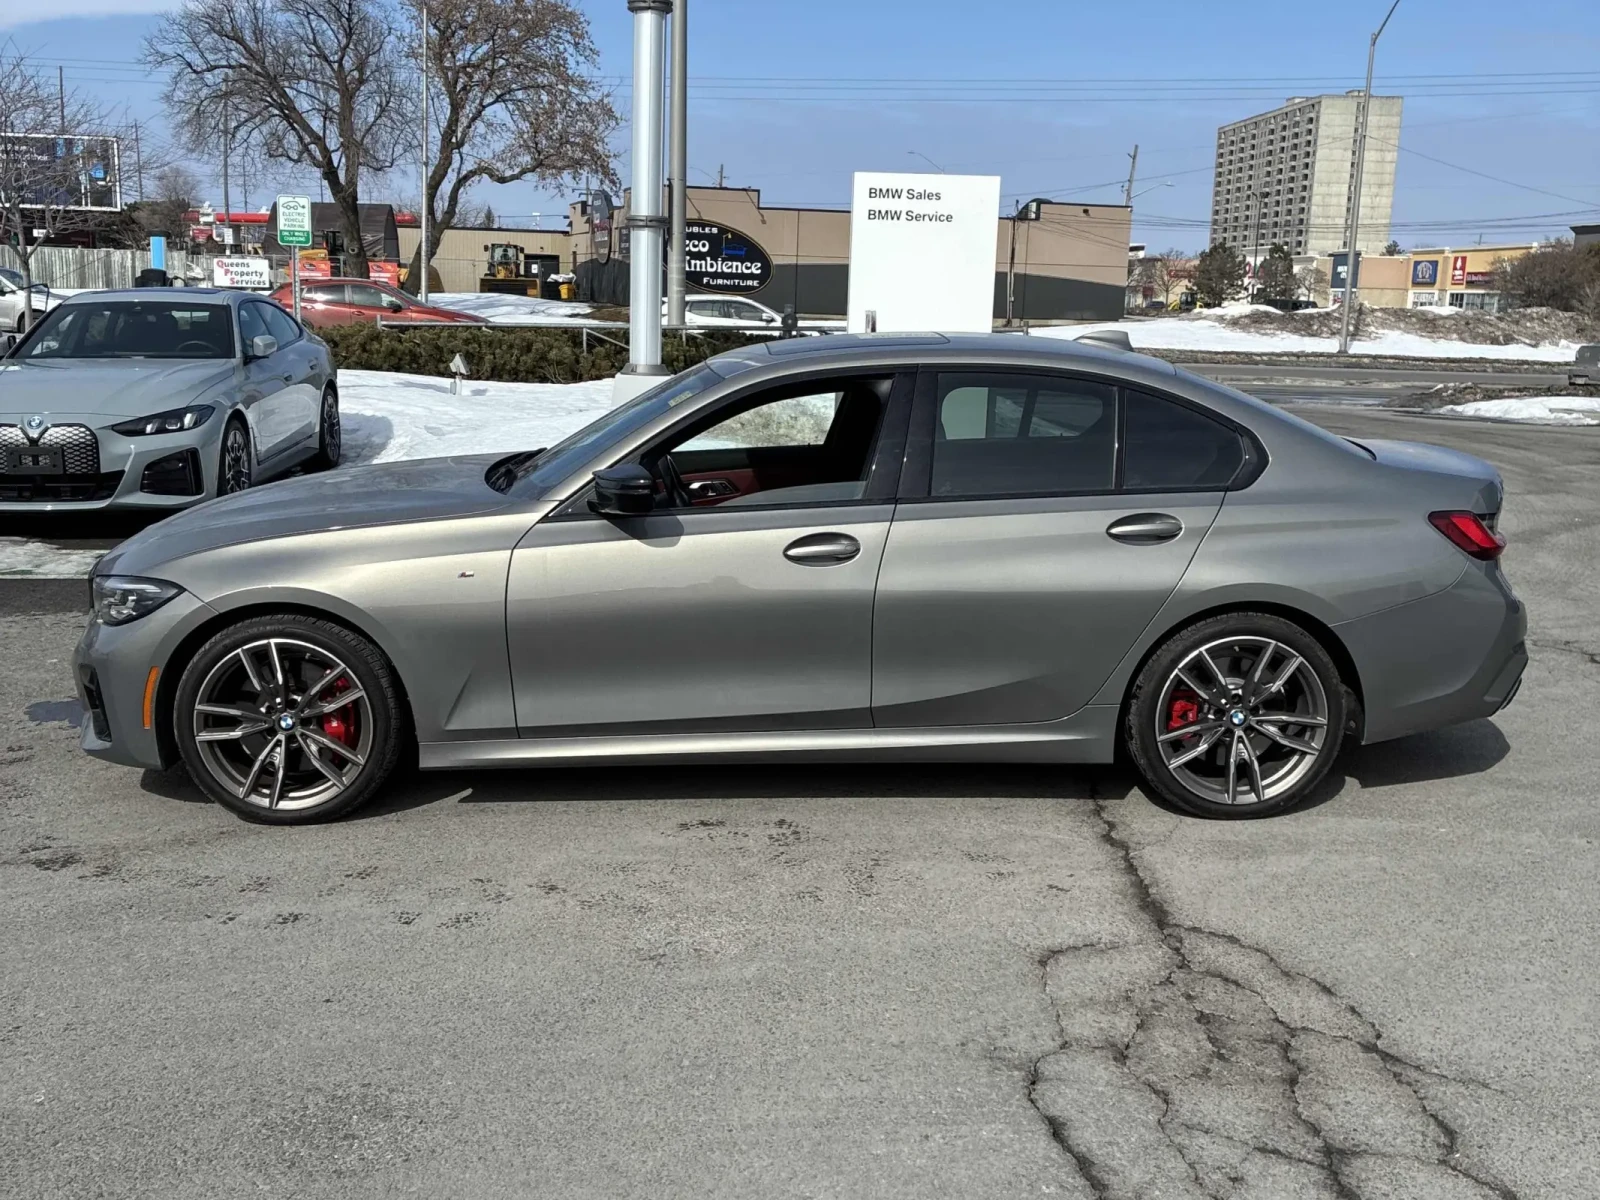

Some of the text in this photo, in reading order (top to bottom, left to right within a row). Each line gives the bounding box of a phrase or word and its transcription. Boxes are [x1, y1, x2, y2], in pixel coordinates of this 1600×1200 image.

[868, 187, 942, 201] BMW Sales
[867, 209, 953, 223] BMW Service
[686, 226, 718, 234] UBLES
[216, 259, 250, 269] Queens
[224, 268, 264, 279] Property
[230, 277, 266, 286] Services
[703, 277, 760, 287] FURNITURE
